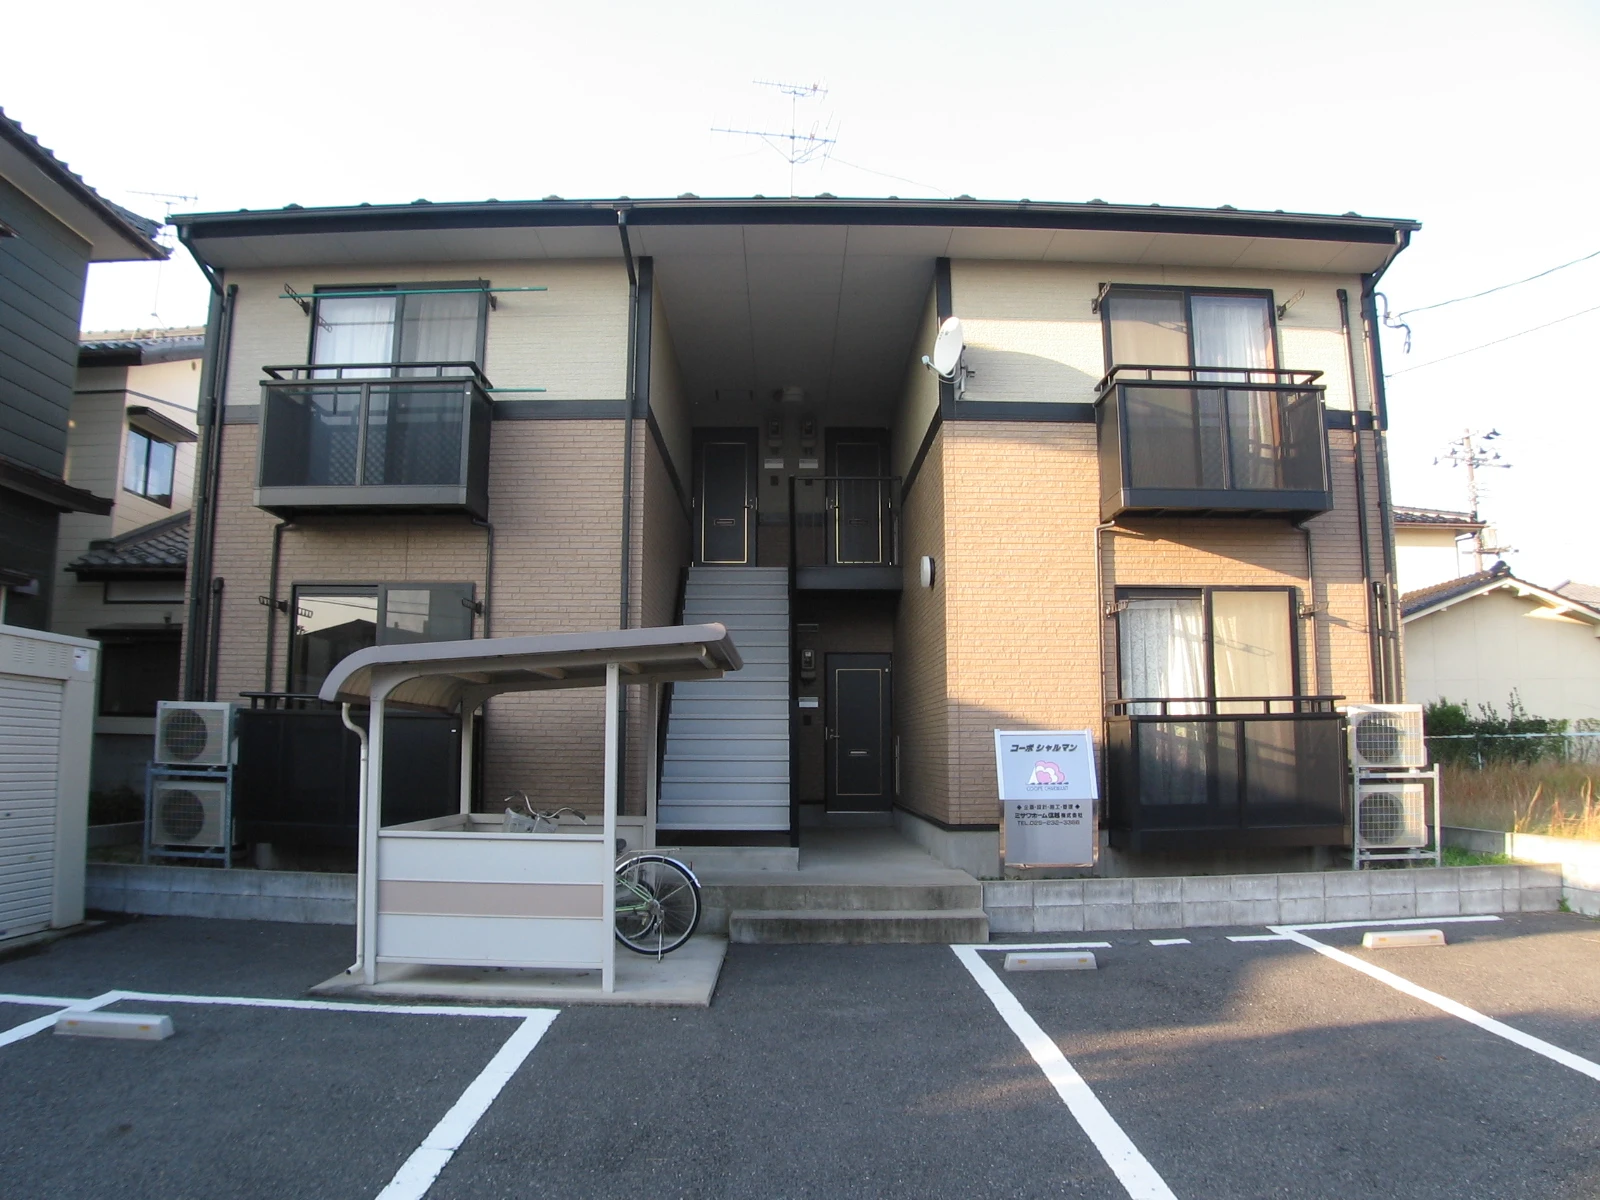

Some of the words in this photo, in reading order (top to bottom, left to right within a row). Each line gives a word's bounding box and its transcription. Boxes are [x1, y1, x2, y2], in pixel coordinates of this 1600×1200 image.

[1036, 744, 1078, 752] シャルマン
